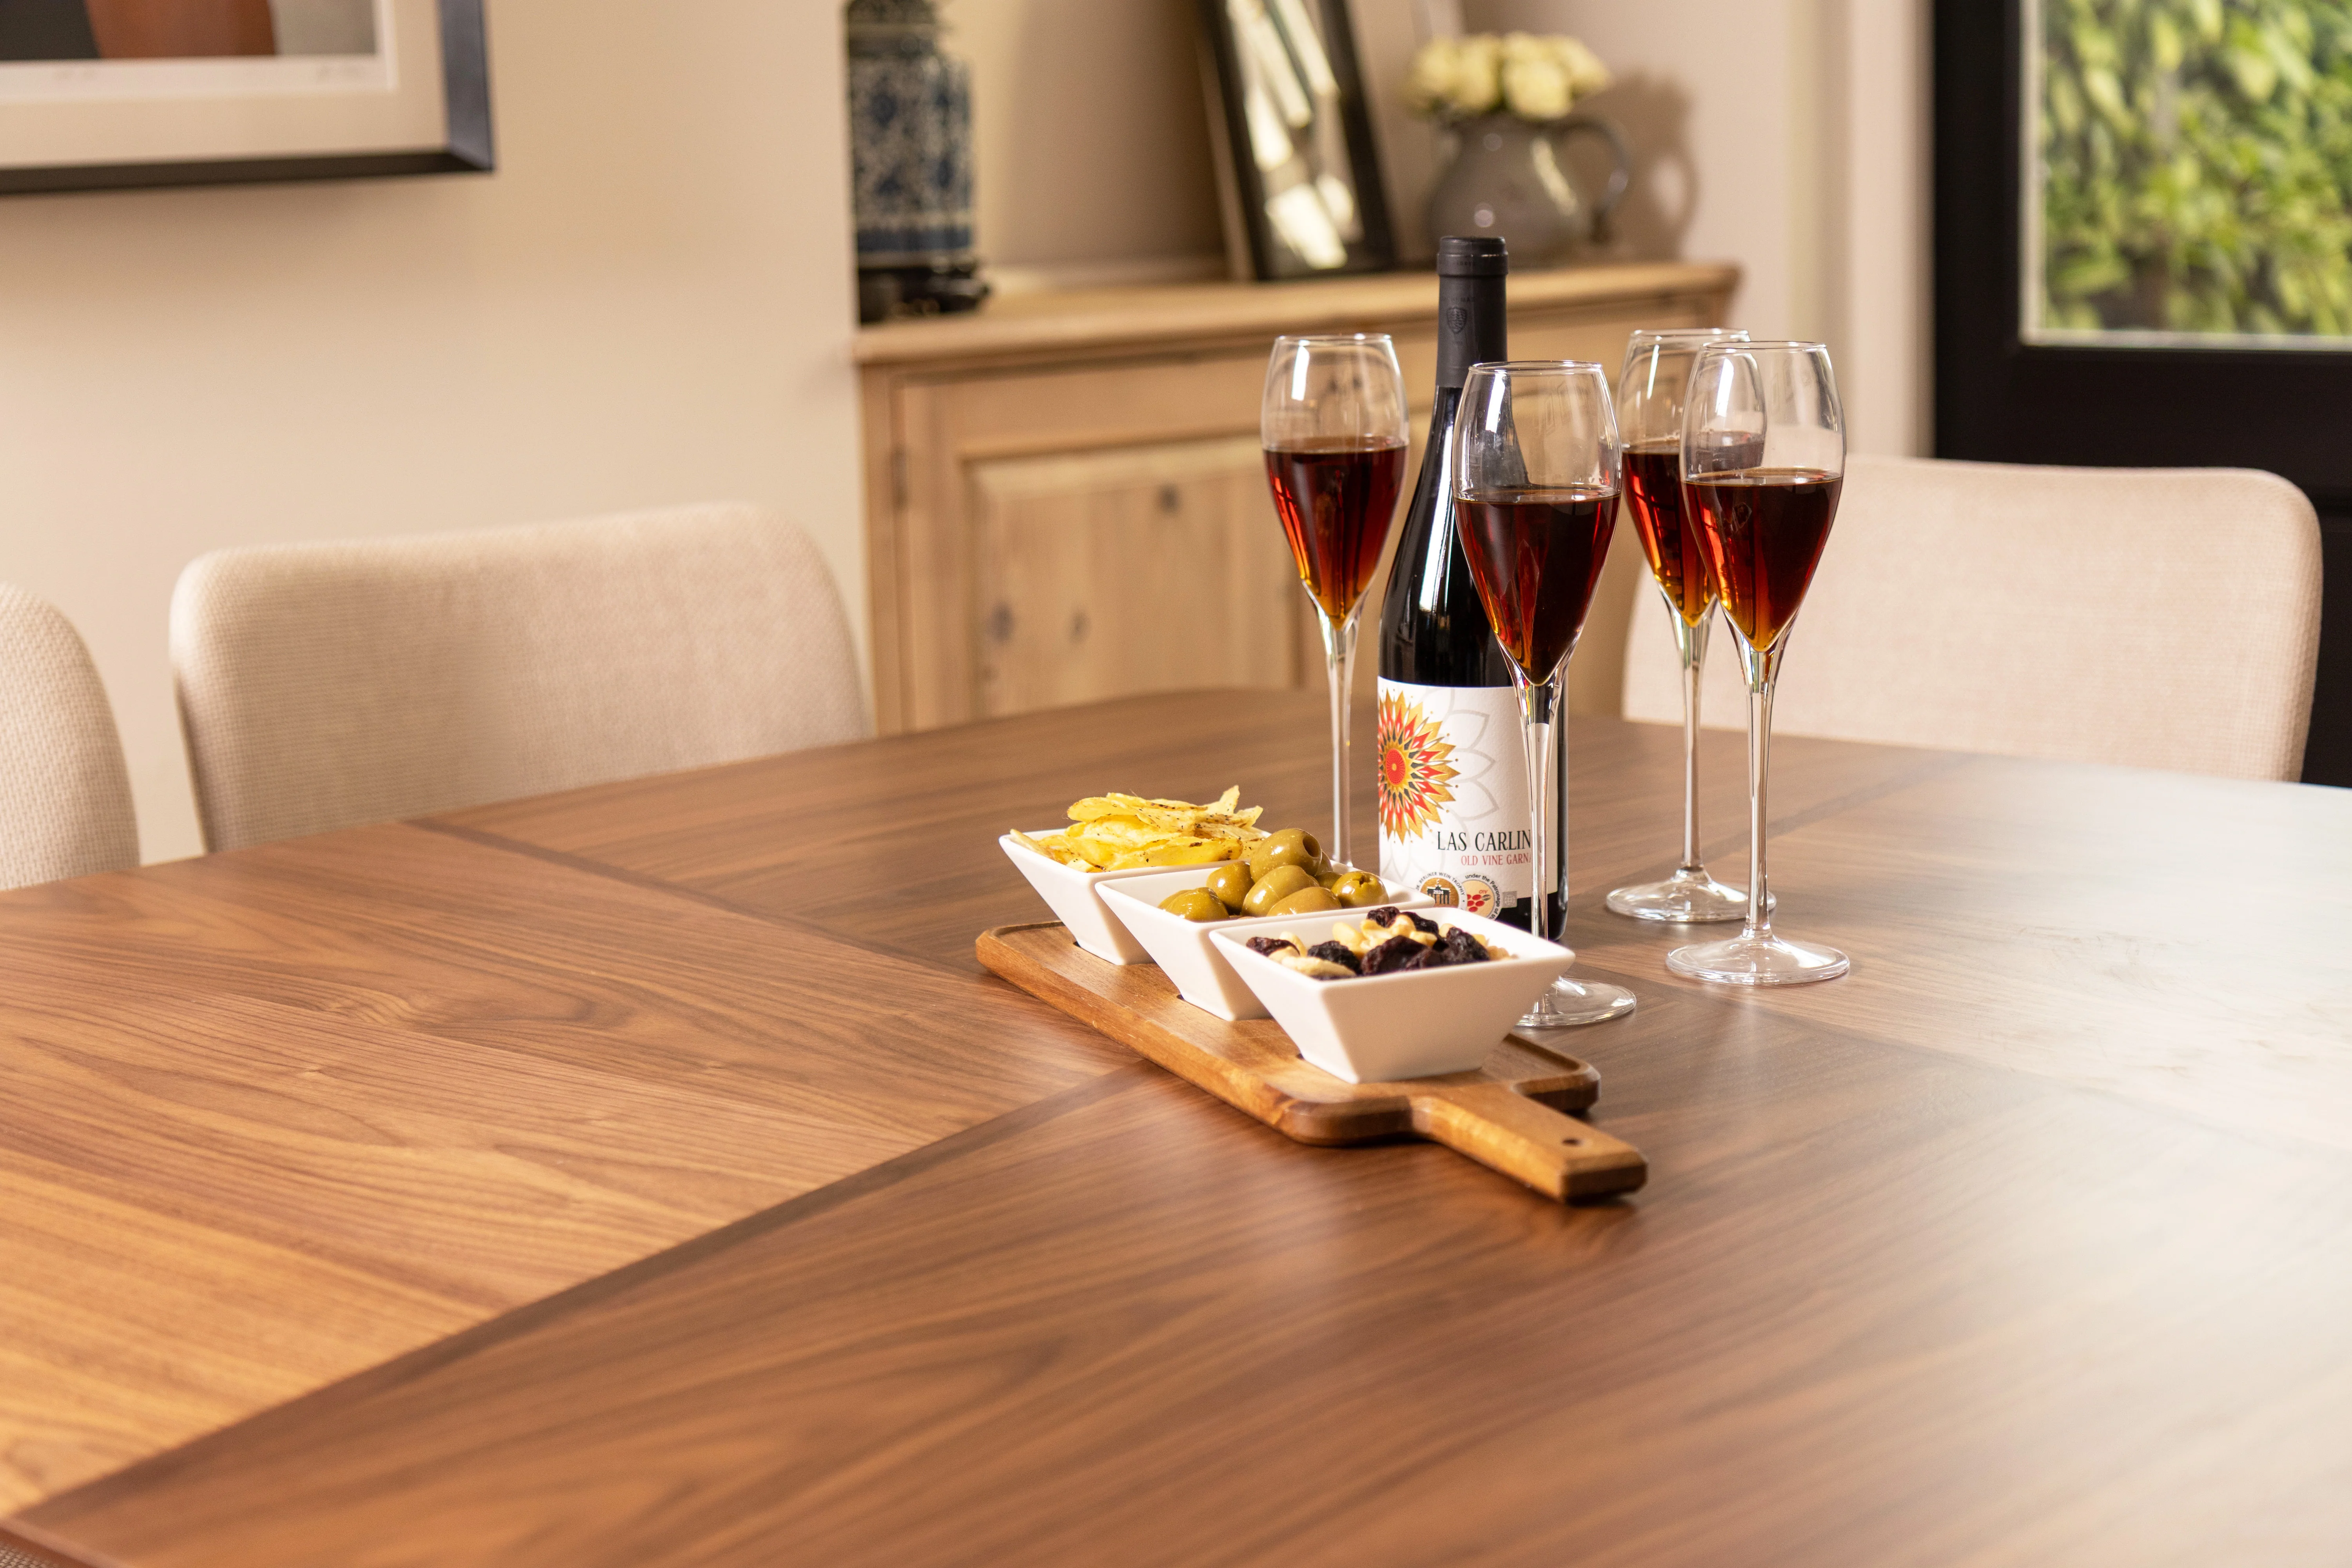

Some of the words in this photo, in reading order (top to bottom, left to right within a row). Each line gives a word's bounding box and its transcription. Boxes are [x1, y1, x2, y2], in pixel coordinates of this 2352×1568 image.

[1437, 831, 1467, 851] LAS
[1475, 829, 1531, 851] CARLIN
[1461, 855, 1478, 866] OLD
[1482, 855, 1503, 866] VINE
[1506, 852, 1531, 865] GARN
[1419, 872, 1437, 884] BERLINER
[1452, 877, 1465, 895] TROPHY
[1490, 880, 1501, 907] Patronage
